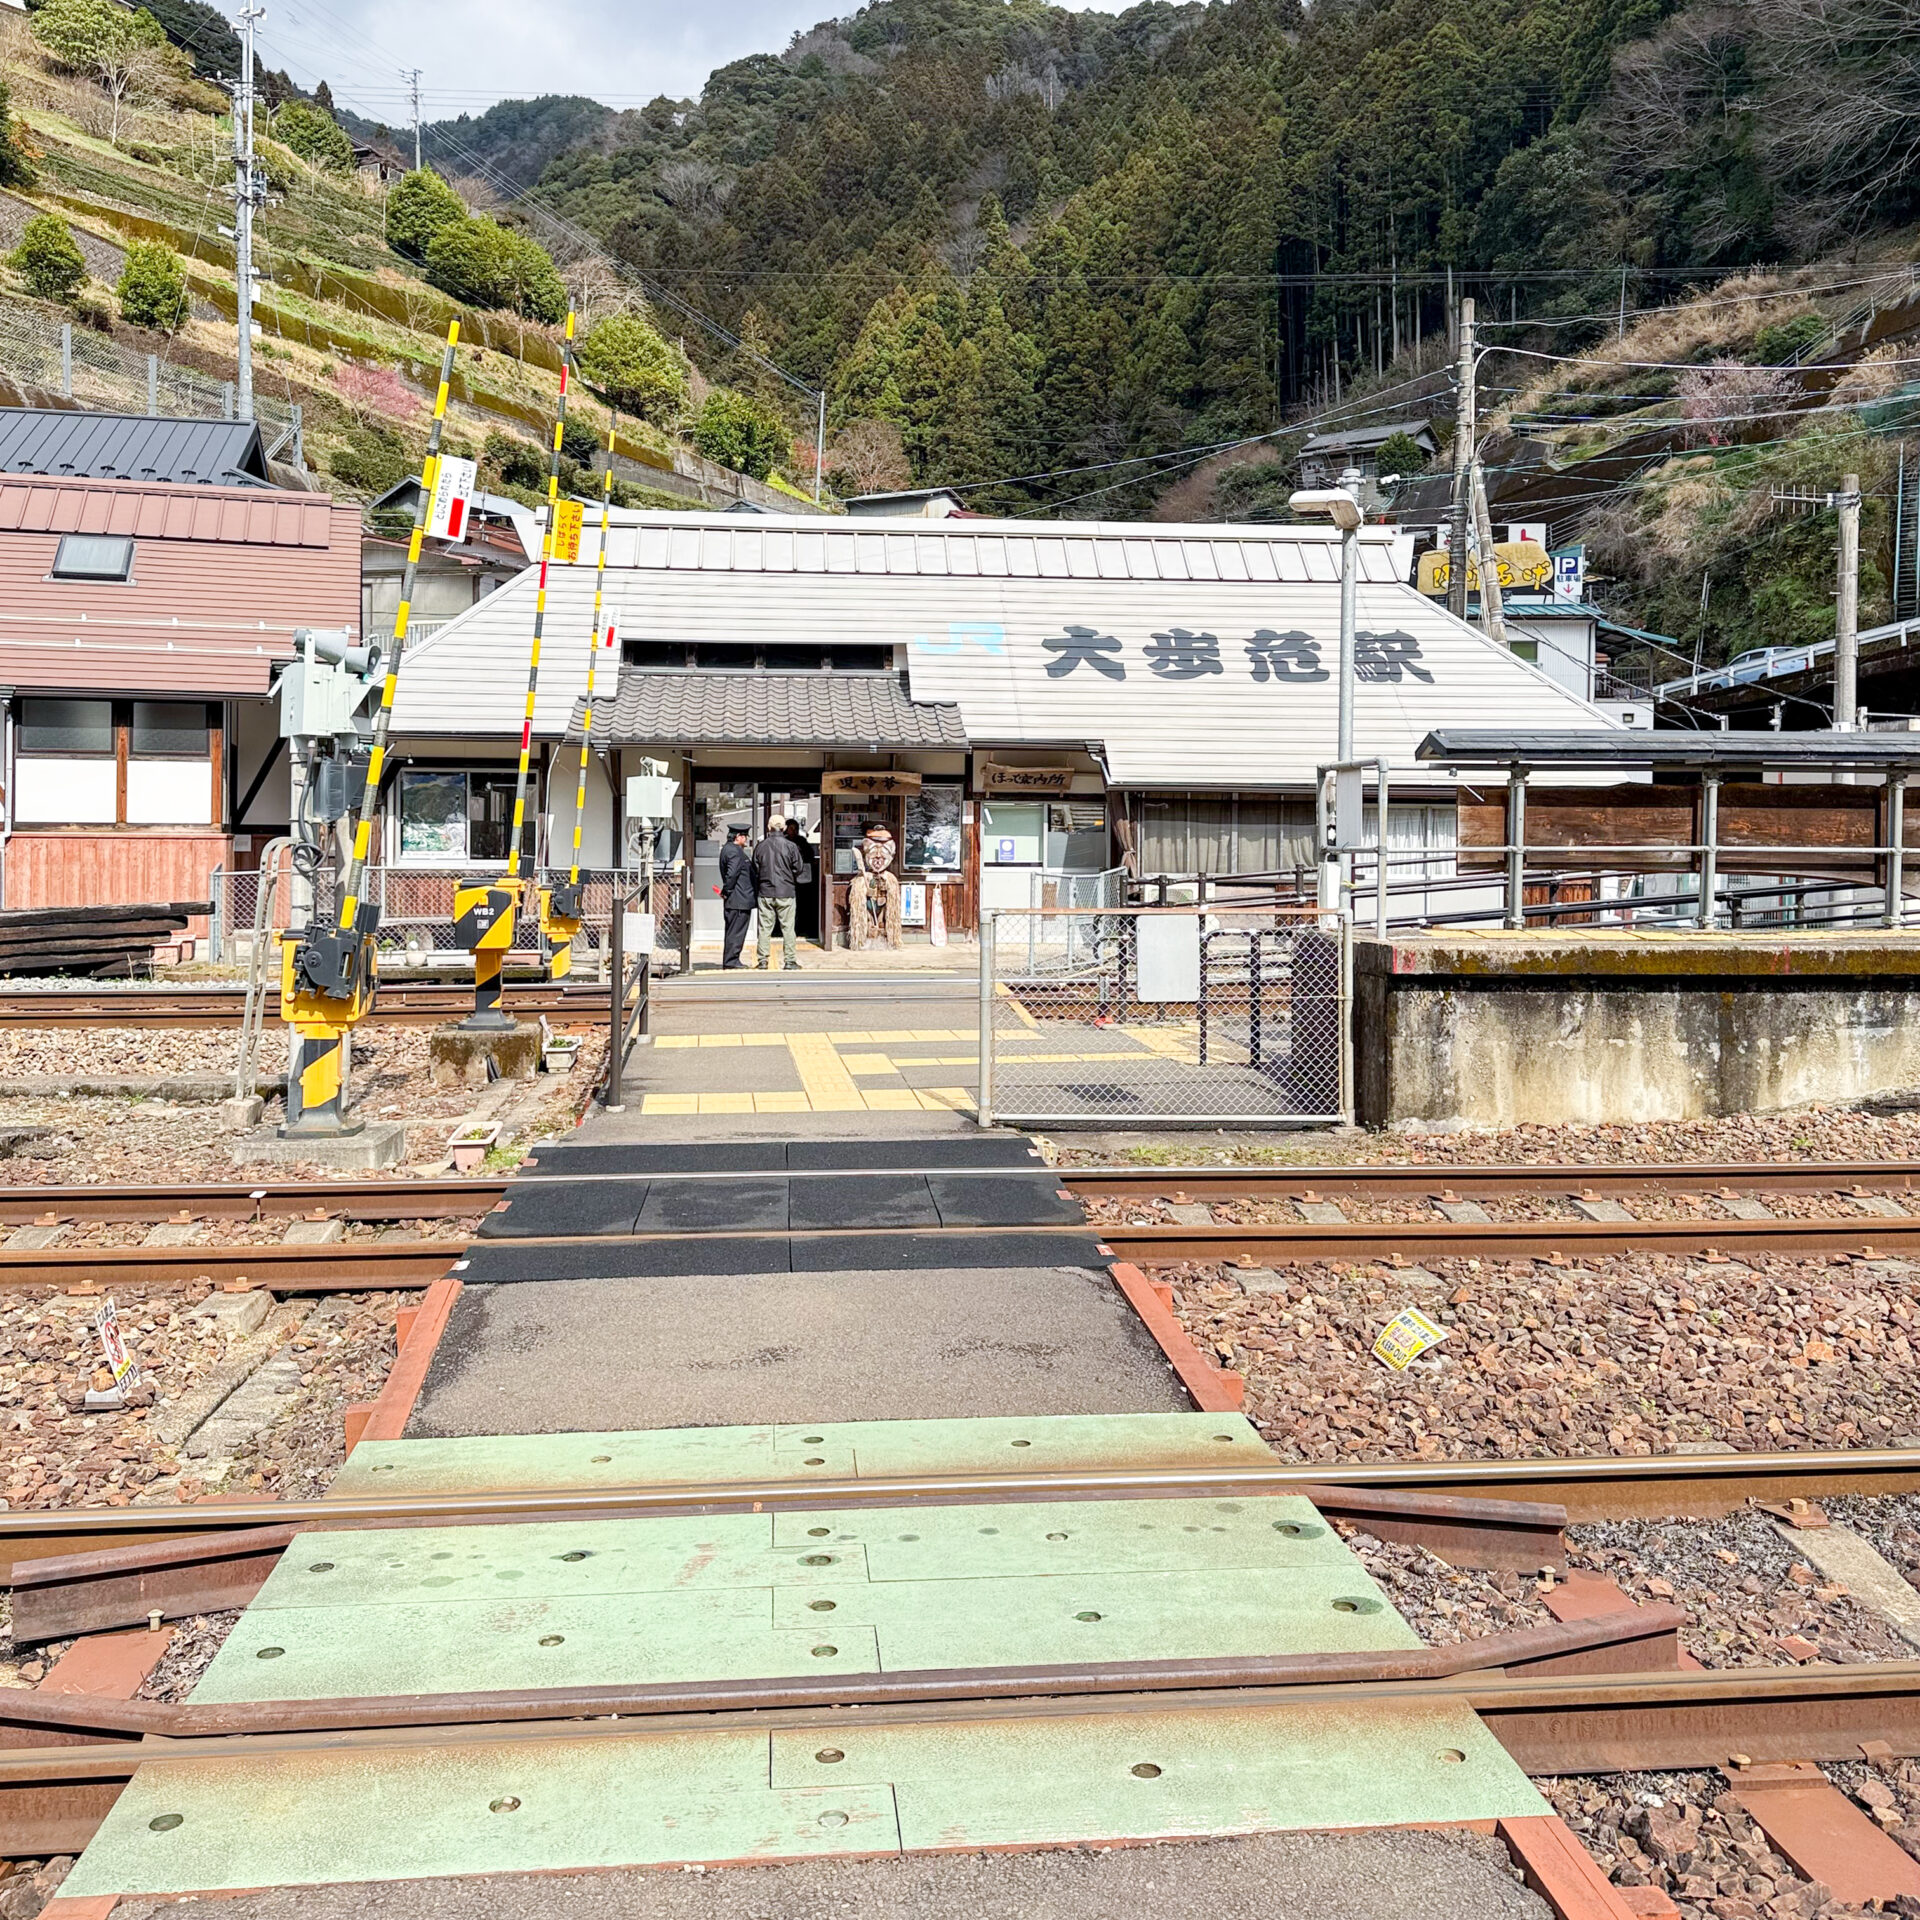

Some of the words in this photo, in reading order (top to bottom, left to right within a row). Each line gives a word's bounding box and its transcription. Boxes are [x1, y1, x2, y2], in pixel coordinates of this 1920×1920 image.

[557, 513, 568, 546] しばらく
[567, 504, 580, 561] お待ち下さい
[1562, 558, 1576, 573] P
[915, 622, 1006, 655] JR
[1041, 625, 1435, 684] 大歩危駅
[473, 907, 495, 916] WB2
[1382, 1339, 1396, 1353] KEEP
[1393, 1348, 1407, 1362] OUT
